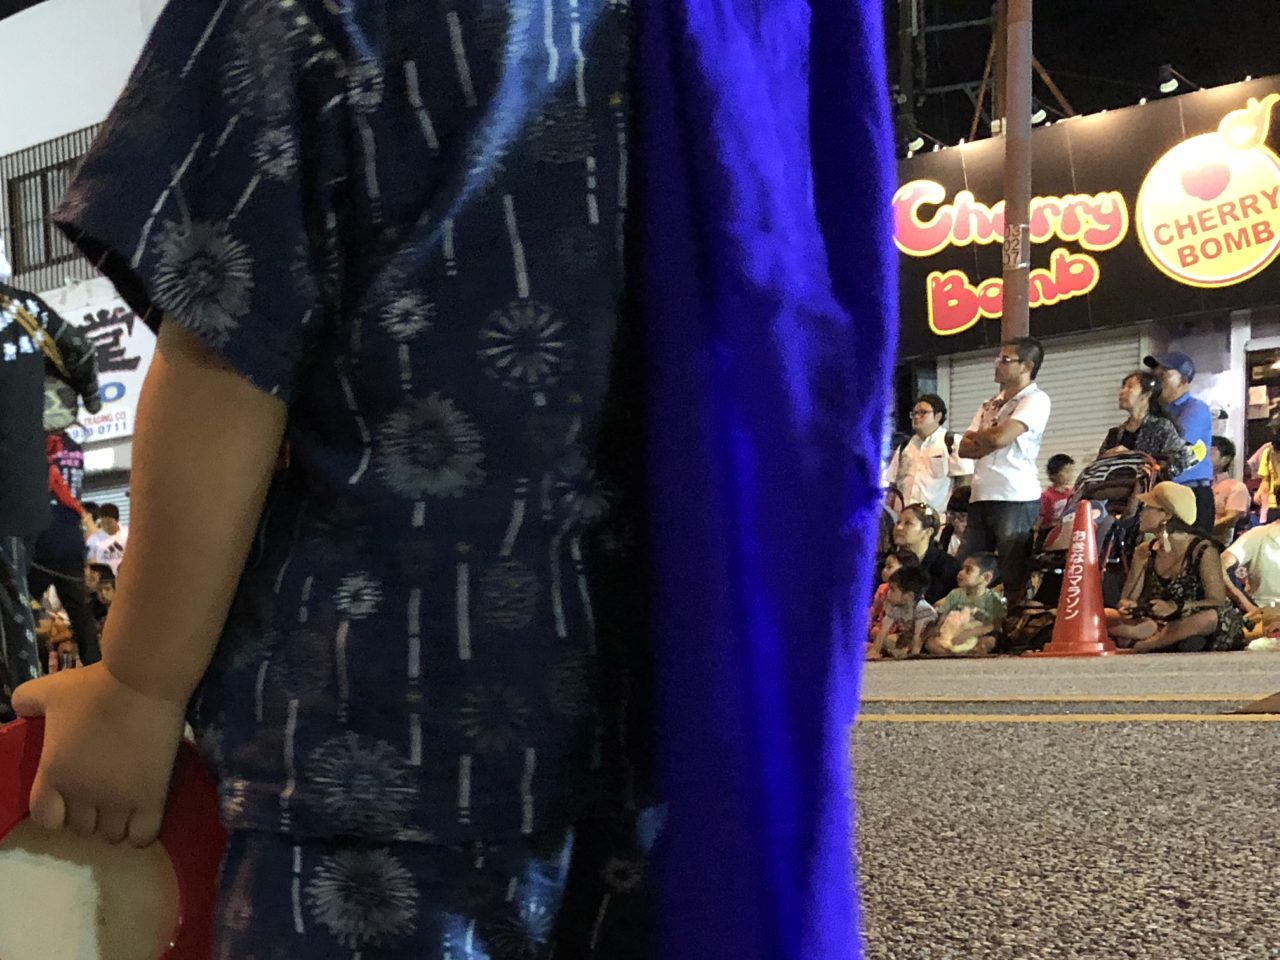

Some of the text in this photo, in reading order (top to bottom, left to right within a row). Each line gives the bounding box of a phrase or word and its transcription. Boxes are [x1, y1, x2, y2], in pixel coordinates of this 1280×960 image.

[1153, 185, 1280, 246] CHERRY
[1177, 220, 1275, 268] BOMB
[97, 421, 127, 435] 0711
[1064, 529, 1087, 621] おきなわマラソン
